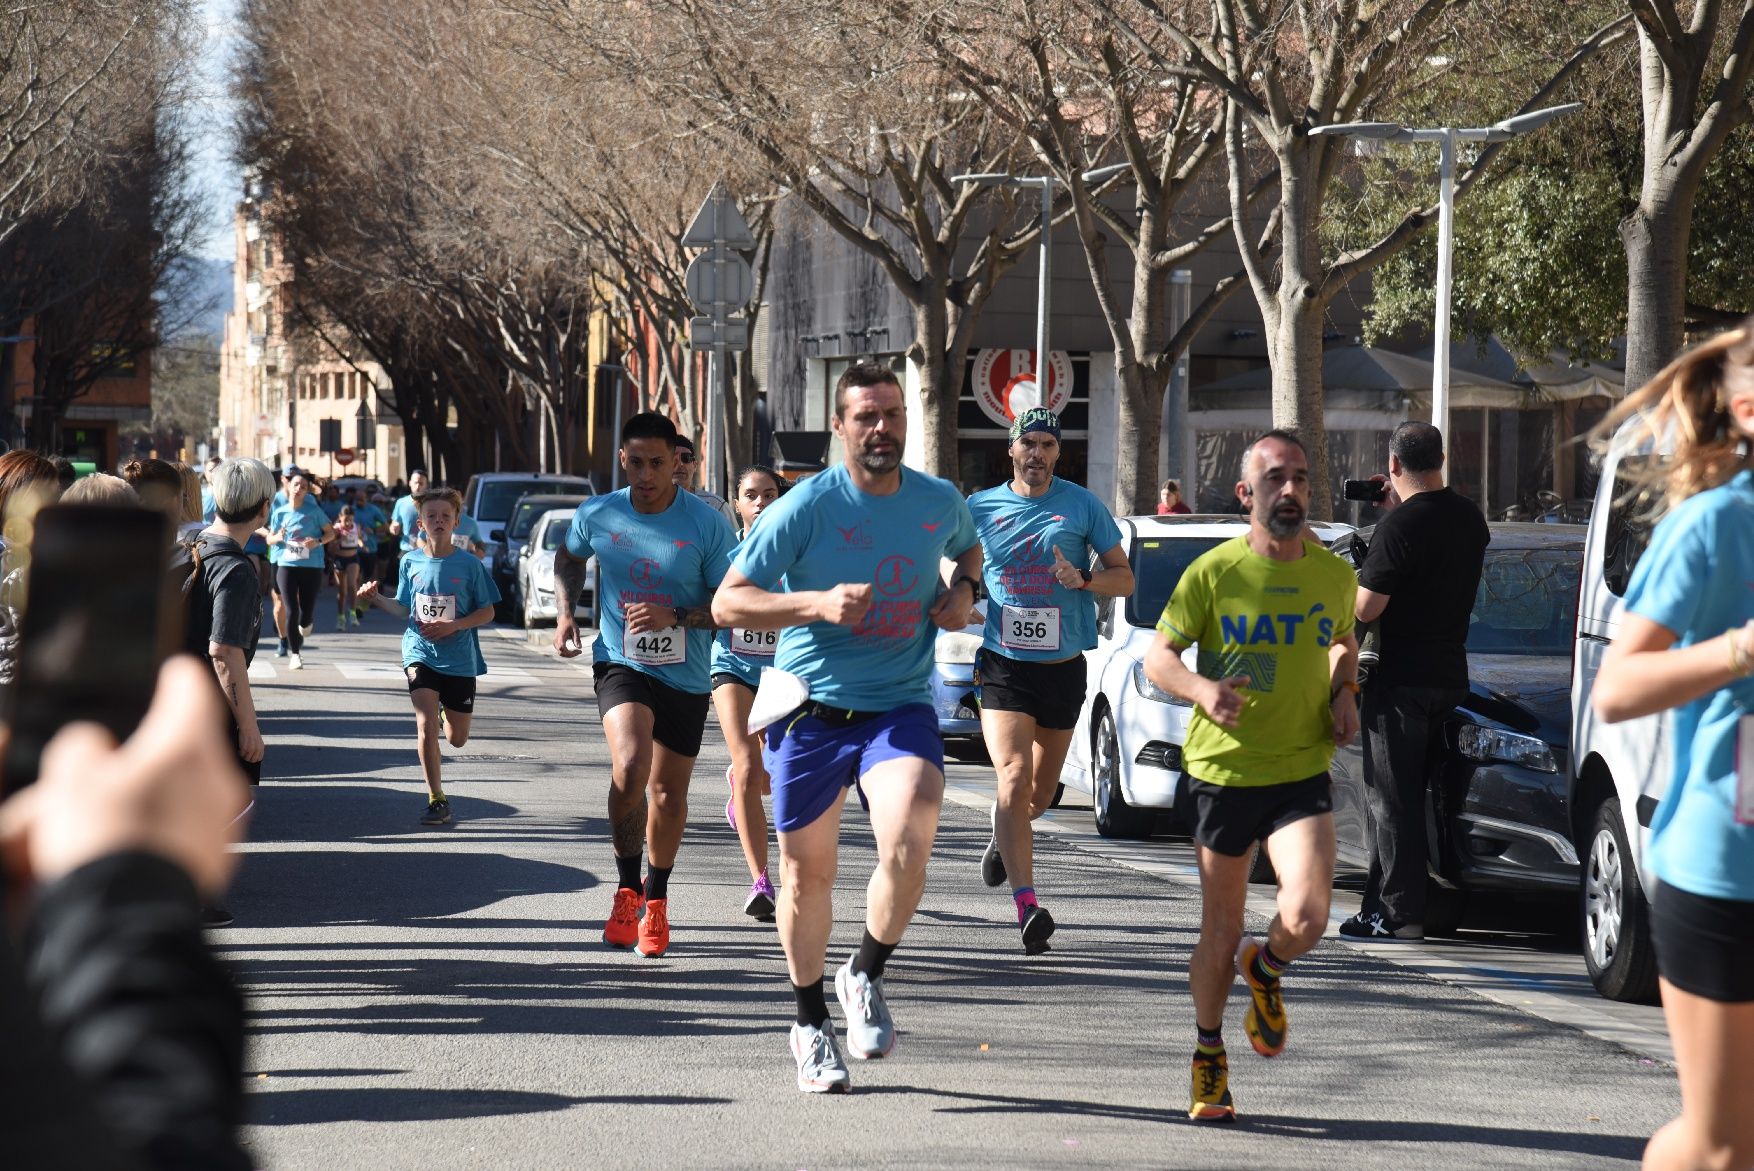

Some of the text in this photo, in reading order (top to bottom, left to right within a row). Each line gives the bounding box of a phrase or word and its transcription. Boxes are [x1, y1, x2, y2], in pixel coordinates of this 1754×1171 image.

[422, 604, 447, 618] 657
[743, 629, 776, 645] 616
[1012, 620, 1047, 639] 356
[636, 636, 673, 654] 442
